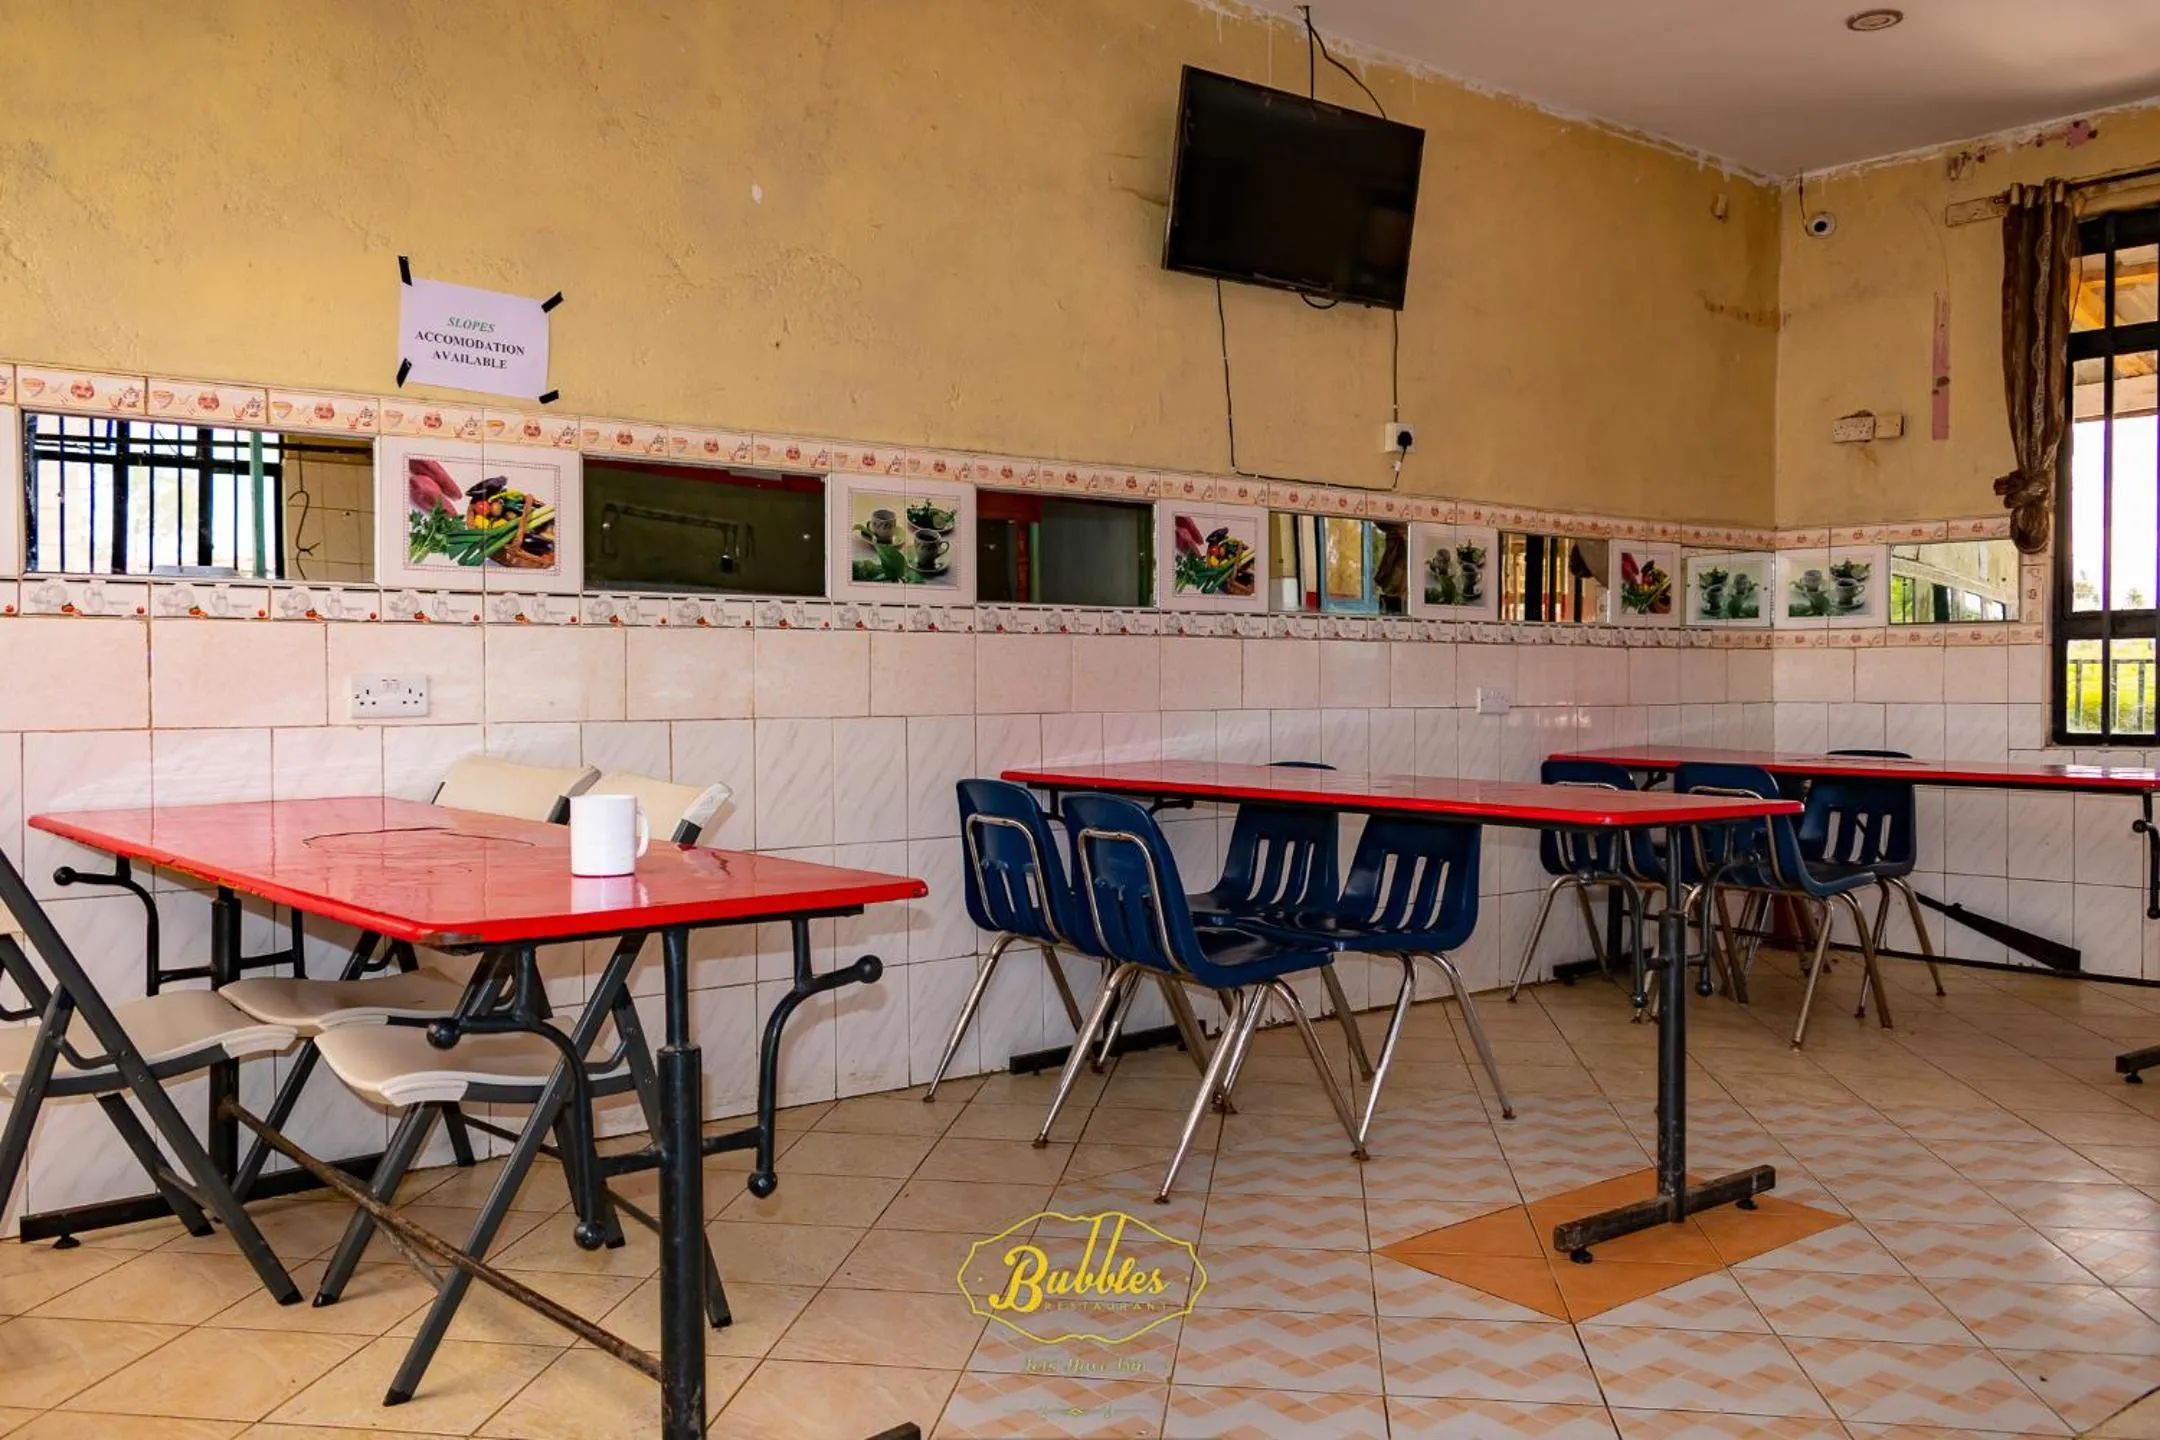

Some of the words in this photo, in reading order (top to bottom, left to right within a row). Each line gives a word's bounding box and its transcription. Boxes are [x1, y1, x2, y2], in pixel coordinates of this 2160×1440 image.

[447, 316, 497, 333] SLOPES
[415, 330, 526, 356] ACCOMODATION
[432, 350, 508, 369] AVAILABLE
